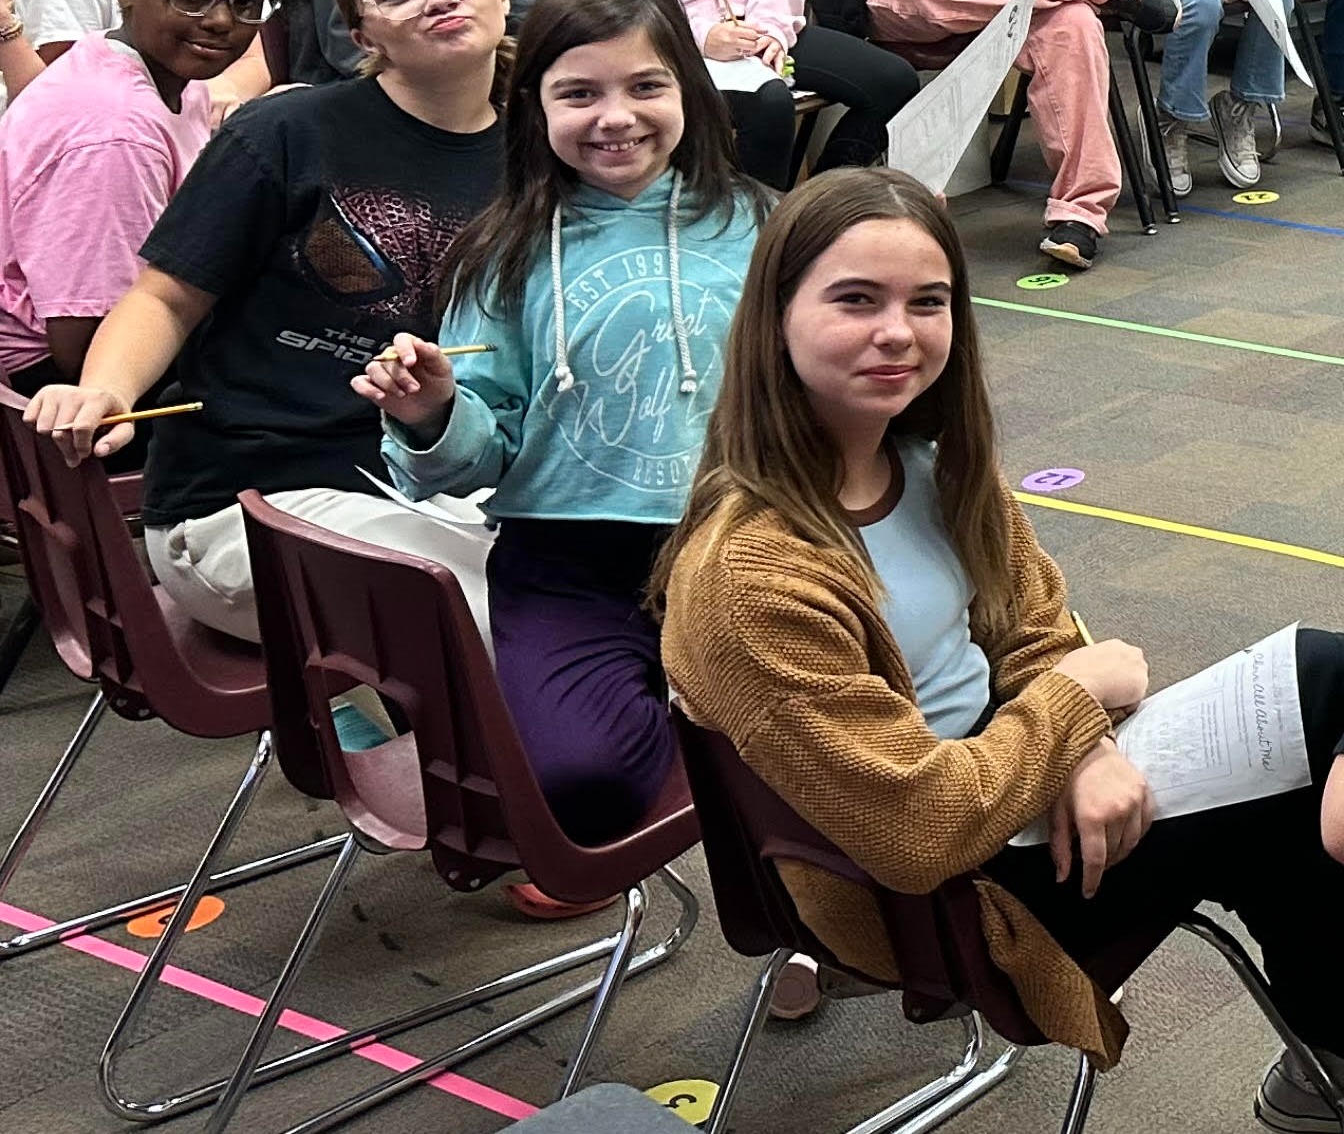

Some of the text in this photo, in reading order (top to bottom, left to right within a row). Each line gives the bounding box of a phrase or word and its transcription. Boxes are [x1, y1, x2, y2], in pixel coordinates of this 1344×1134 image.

[566, 270, 612, 312] EST
[324, 327, 376, 349] THE
[1034, 472, 1075, 486] 12
